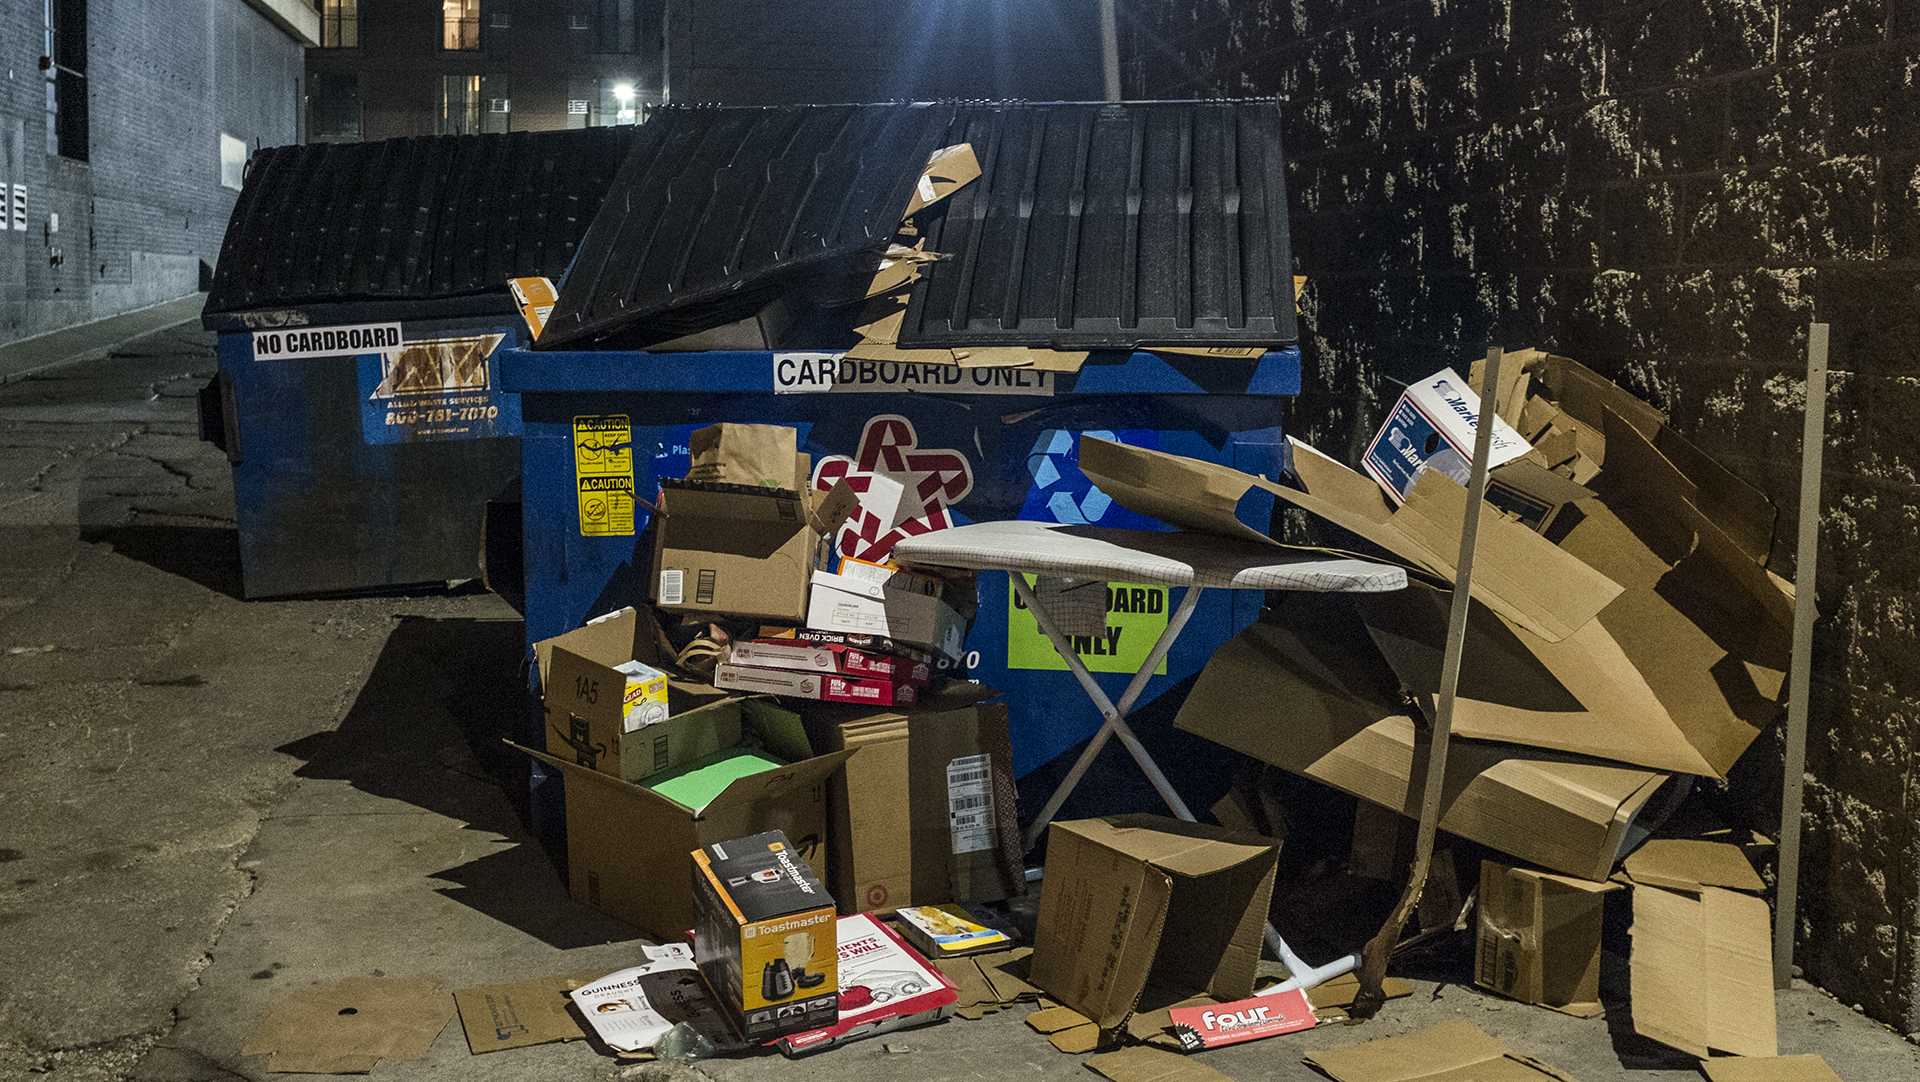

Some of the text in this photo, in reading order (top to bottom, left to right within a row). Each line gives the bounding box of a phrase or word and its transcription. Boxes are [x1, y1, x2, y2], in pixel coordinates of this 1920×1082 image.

[256, 327, 399, 354] NO CARDBOARD
[777, 358, 1048, 388] CARDBOARD ONLY
[587, 419, 628, 431] CAUTION
[1446, 397, 1480, 431] Marke
[1400, 443, 1429, 474] Mark
[591, 478, 632, 490] CAUTION
[799, 632, 820, 641] OVEN
[821, 634, 845, 643] BRICK
[775, 849, 816, 895] Toastmaster
[757, 913, 832, 935] Toastmaster
[581, 979, 641, 996] GUINNESS
[1201, 1005, 1271, 1032] four
